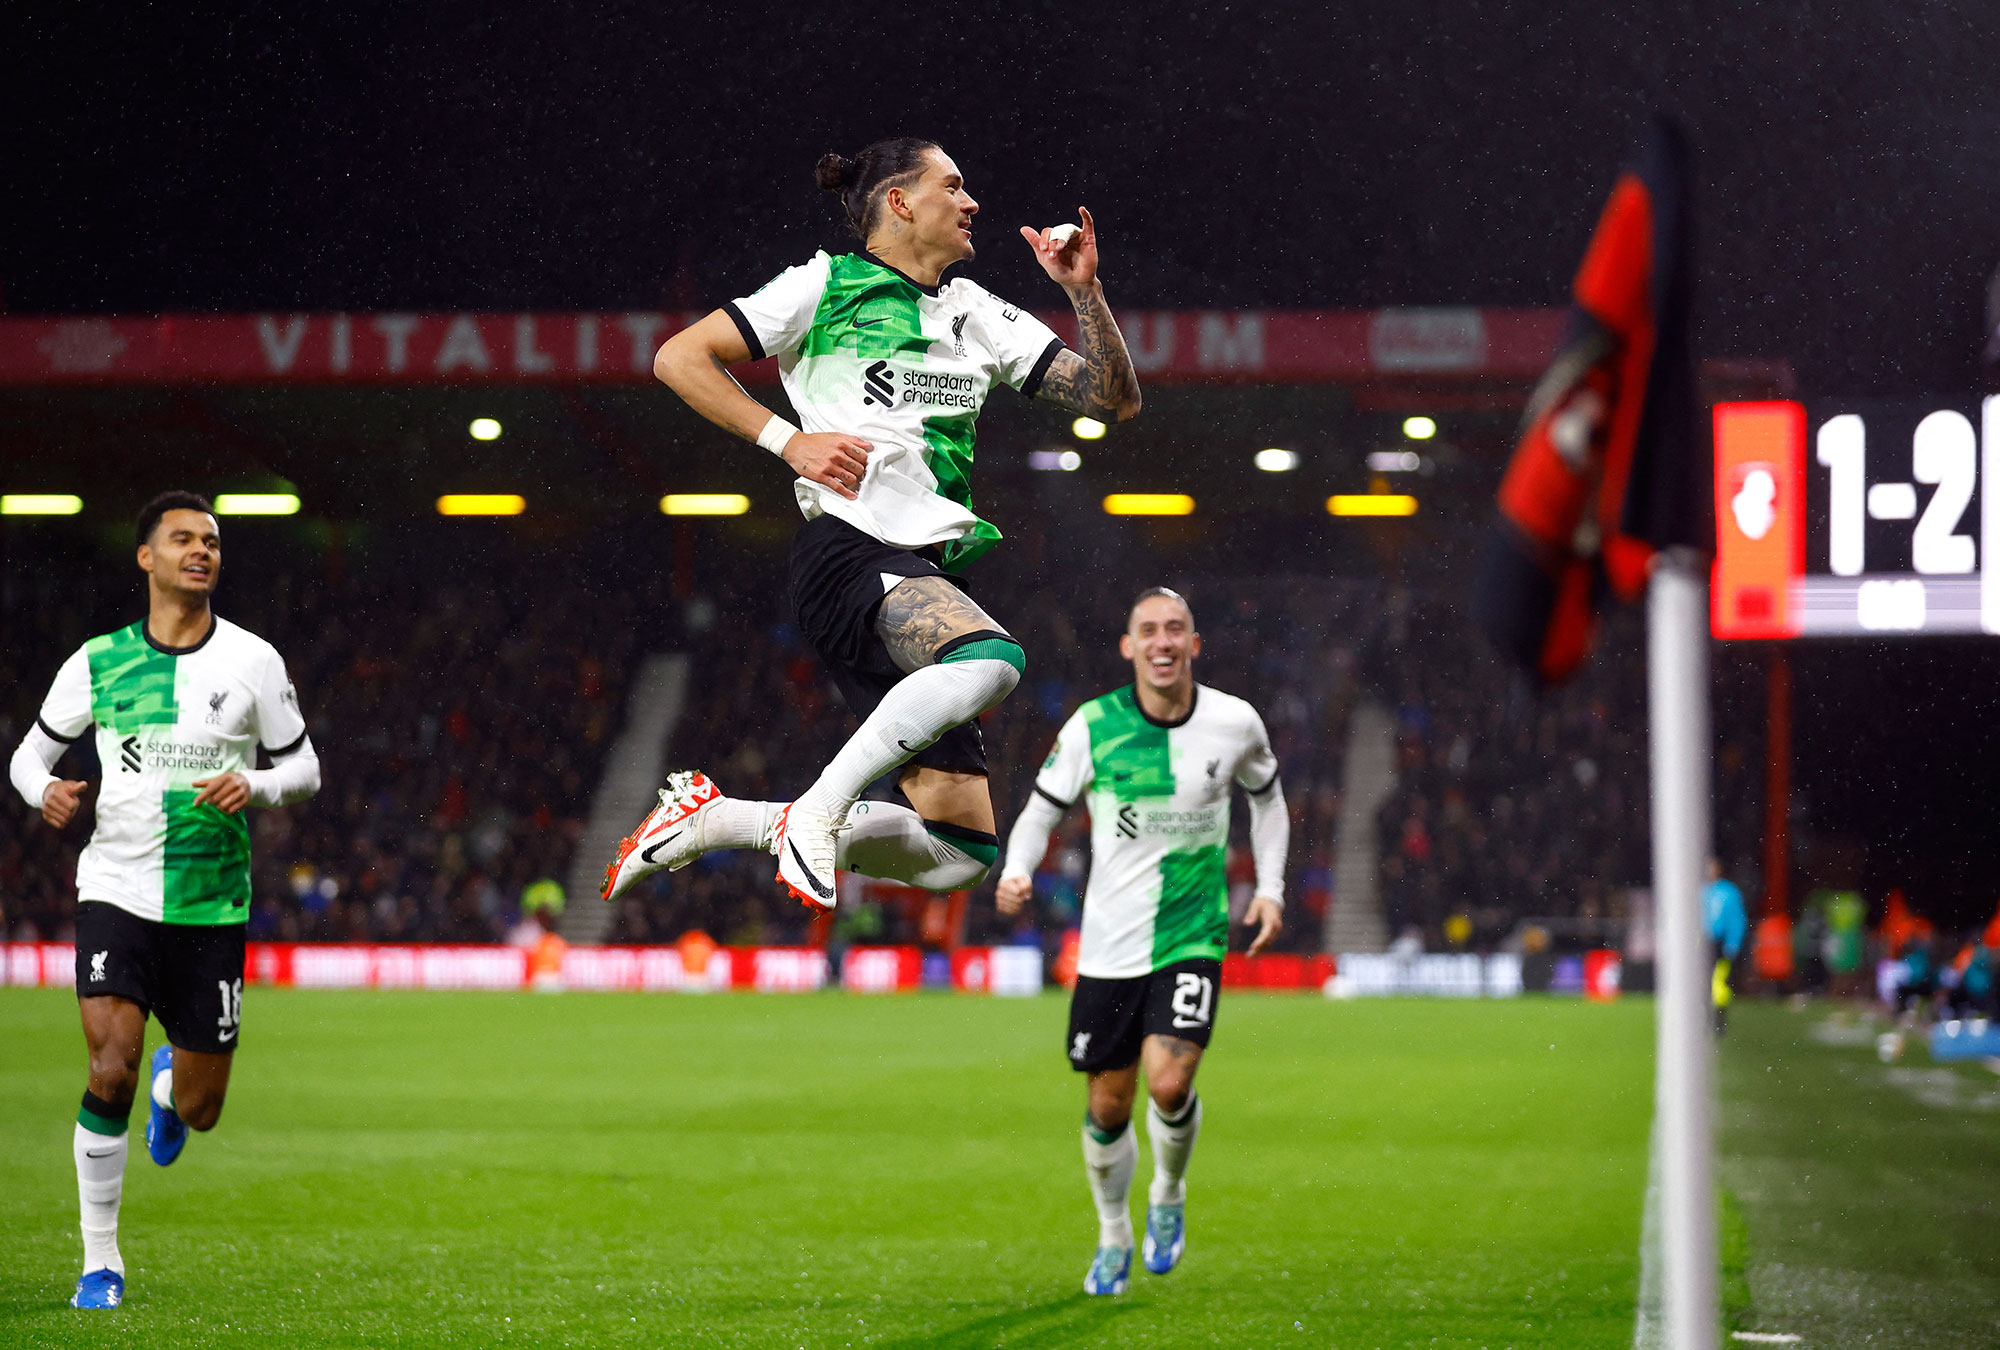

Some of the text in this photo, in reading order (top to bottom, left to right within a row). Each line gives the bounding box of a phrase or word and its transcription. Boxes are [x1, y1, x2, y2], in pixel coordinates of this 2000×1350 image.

[256, 312, 704, 374] VITALIT
[903, 370, 974, 392] standard
[903, 387, 976, 409] chartered
[1817, 409, 1977, 576] 1-2
[147, 740, 221, 757] standard
[147, 754, 223, 770] chartered
[217, 977, 242, 1027] 18
[1172, 972, 1213, 1022] 21
